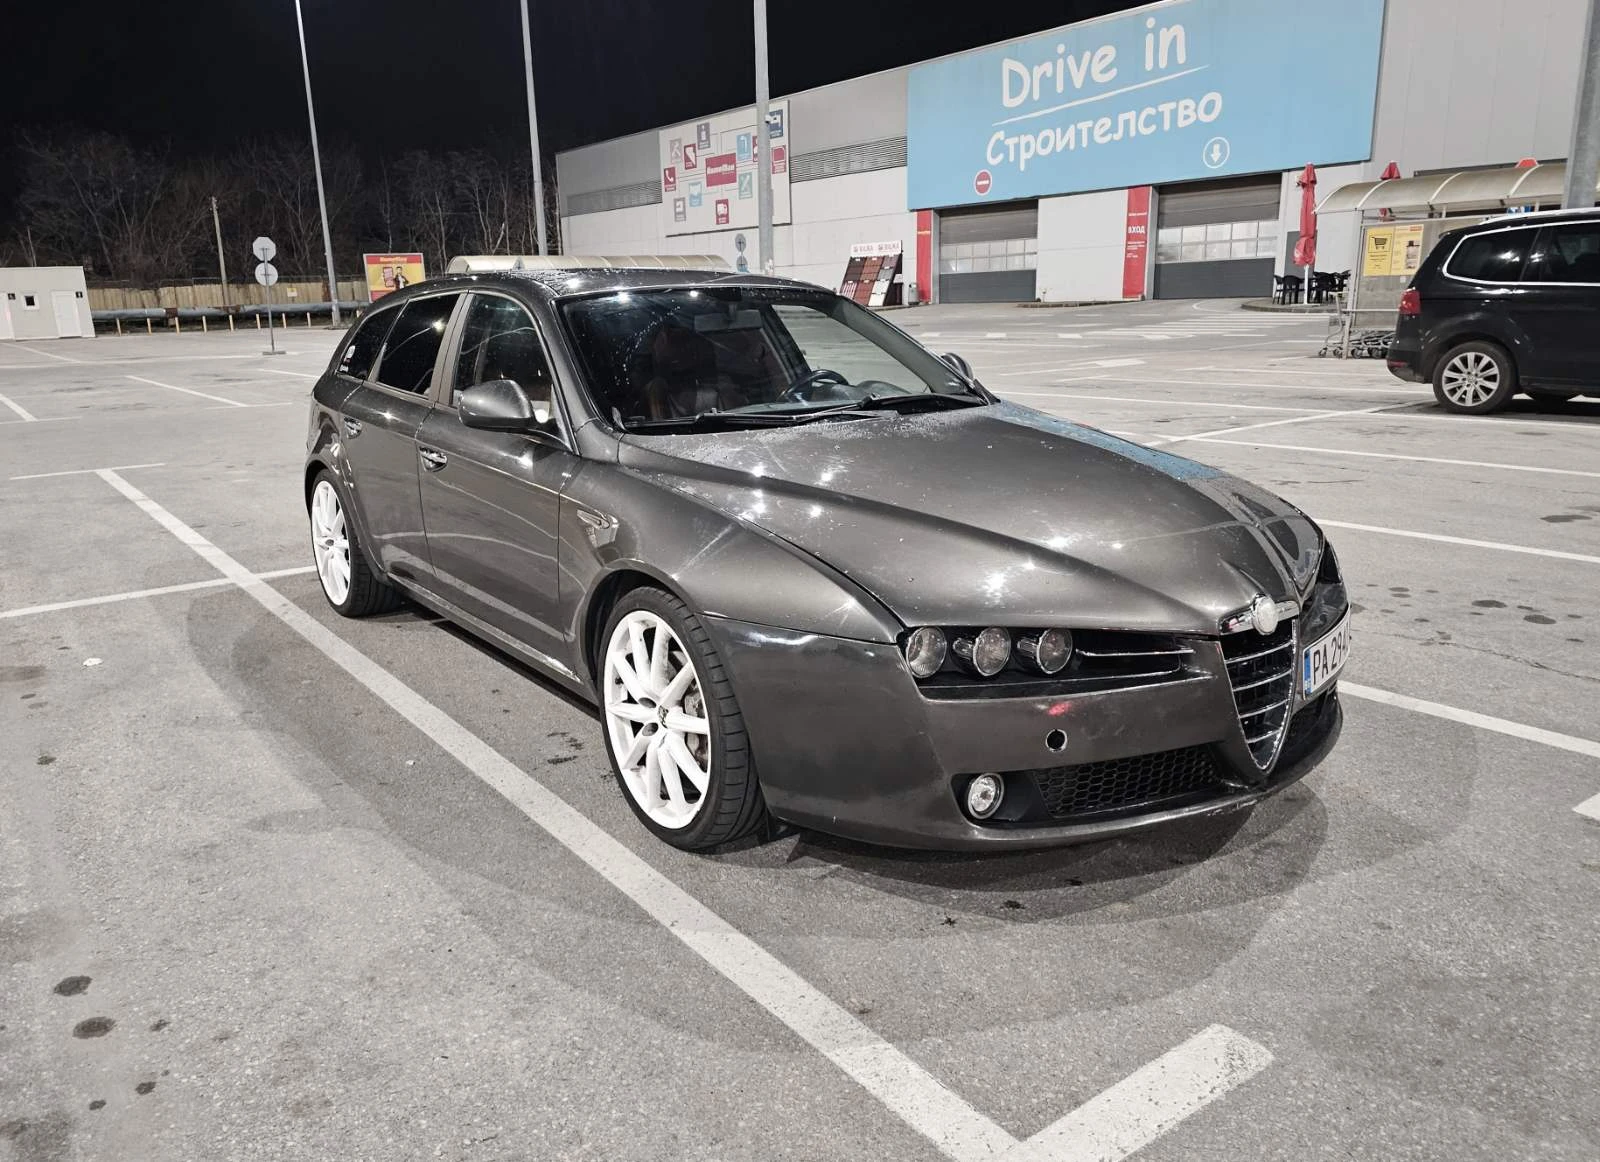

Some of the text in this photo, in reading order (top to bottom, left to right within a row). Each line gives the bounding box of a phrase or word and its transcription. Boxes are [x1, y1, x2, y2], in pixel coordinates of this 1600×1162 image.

[1002, 16, 1187, 108] Drive in
[986, 91, 1223, 172] Строителство
[1313, 643, 1329, 686] PA
